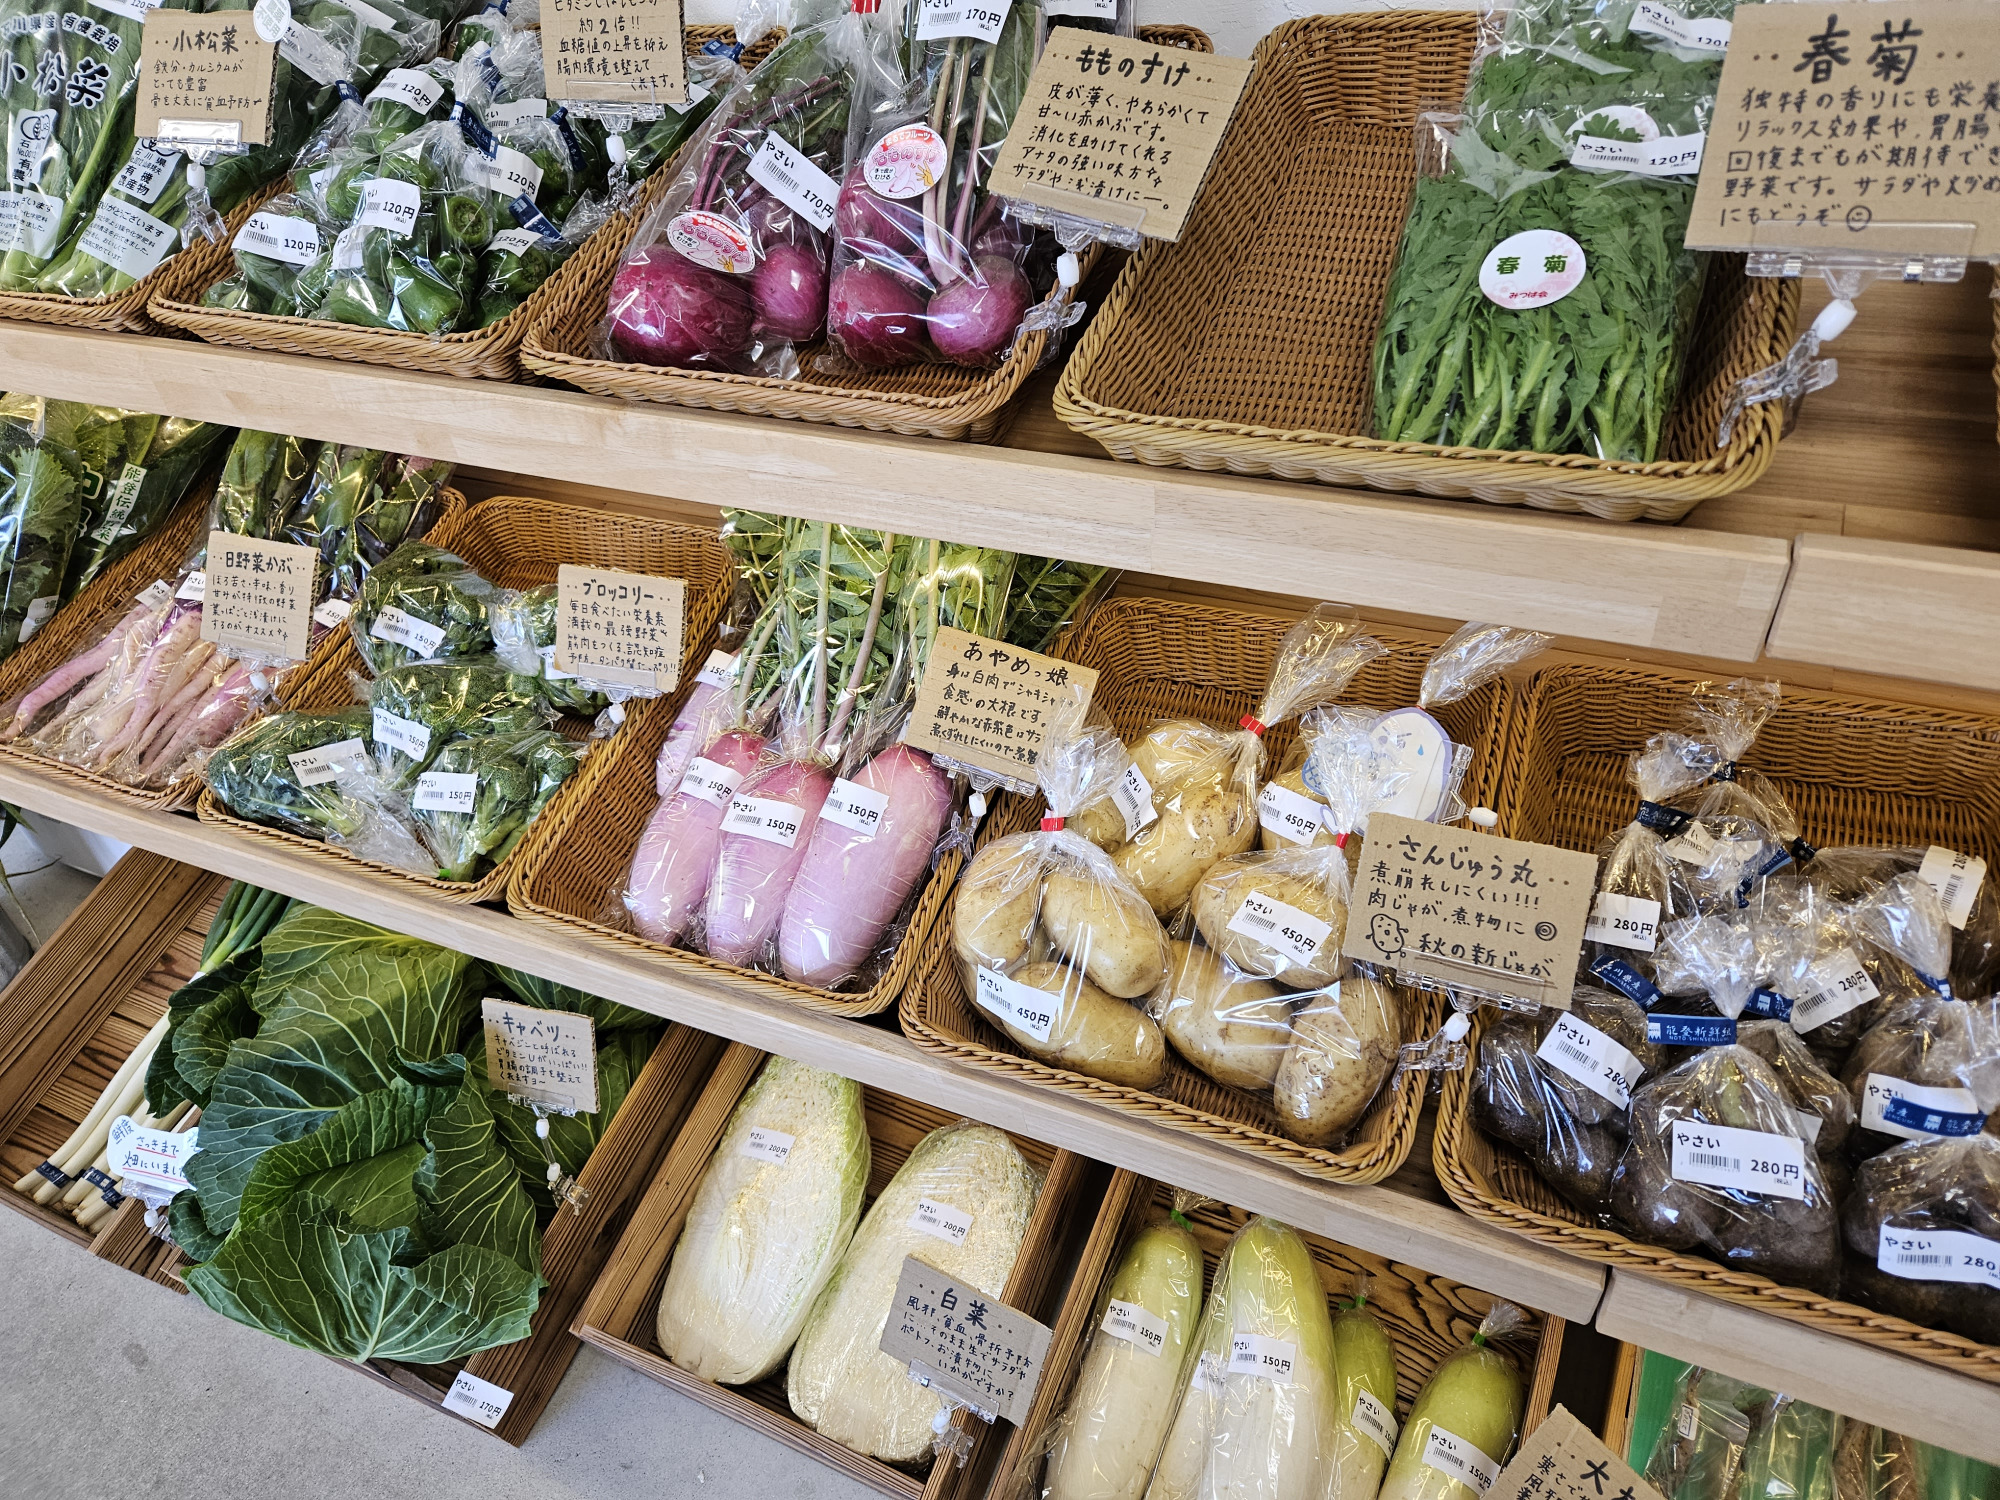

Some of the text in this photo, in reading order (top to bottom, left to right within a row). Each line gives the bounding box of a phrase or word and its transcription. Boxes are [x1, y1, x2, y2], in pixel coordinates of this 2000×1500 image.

[966, 8, 1002, 26] 170円
[1640, 5, 1675, 27] やさい
[62, 13, 120, 52] 有機栽培
[173, 25, 240, 55] 小松菜
[559, 35, 669, 54] 血糖値の上昇を抑え
[1793, 13, 1924, 86] 春菊
[153, 59, 245, 74] 鉄分・カルシウムが
[557, 57, 650, 76] 腸内環境を整えて
[1076, 44, 1191, 87] もものすけ
[153, 76, 208, 92] とっても豊富
[630, 73, 675, 91] くれます。
[401, 83, 432, 107] 120円
[1028, 125, 1173, 165] 消化を助けてくれる
[1580, 143, 1624, 154] やさい
[765, 141, 795, 169] やさい
[1022, 146, 1142, 180] アナタの強い味方
[1649, 151, 1698, 167] 120円
[507, 171, 537, 195] 120円
[1723, 174, 1836, 199] 野菜です。
[382, 201, 415, 220] 120円
[802, 189, 835, 218] 170円
[284, 238, 316, 254] 120円
[1496, 254, 1569, 276] 春菊
[226, 551, 294, 575] 日野菜かぶ
[583, 578, 654, 605] ブロッコリー
[380, 610, 404, 623] やさい
[569, 599, 667, 627] 毎日食べたい栄養素
[414, 632, 437, 649] 150円
[963, 640, 1069, 688] あやめっ娘
[375, 712, 397, 727] やさい
[408, 734, 426, 751] 150円
[292, 756, 318, 769] やさい
[707, 779, 733, 797] 150円
[1125, 769, 1142, 794] やさい
[448, 790, 473, 801] 150円
[732, 800, 757, 814] やさい
[847, 803, 880, 823] 150円
[766, 817, 797, 836] 150円
[1285, 812, 1316, 833] 450円
[1399, 834, 1538, 888] さんじゅう丸
[1245, 898, 1273, 915] やさい
[1613, 917, 1654, 936] 280円
[1281, 926, 1317, 952] 450円
[1418, 932, 1554, 977] 秋の新じゃが
[978, 973, 1003, 992] やさい
[1838, 970, 1868, 992] 280円
[1017, 1006, 1050, 1027] 450円
[502, 1011, 560, 1042] キャベツ
[1557, 1021, 1591, 1048] やさい
[1666, 1025, 1732, 1039] 能登新鮮組
[749, 1131, 765, 1140] やさい
[1677, 1132, 1721, 1149] やさい
[768, 1143, 788, 1156] 200円
[1750, 1159, 1799, 1180] 280円
[918, 1202, 937, 1214] やさい
[943, 1221, 966, 1237] 200円
[1885, 1236, 1933, 1250] やさい
[1963, 1255, 2000, 1272] 280
[940, 1287, 989, 1331] 白菜
[1109, 1304, 1130, 1317] やさい
[1140, 1326, 1163, 1345] 150円
[1233, 1340, 1250, 1351] やさい
[1262, 1354, 1291, 1372] 150円
[456, 1378, 475, 1392] やさい
[479, 1401, 502, 1417] 170円
[1358, 1396, 1381, 1416] やさい
[1430, 1432, 1457, 1451] やさい
[1468, 1465, 1493, 1489] 150円
